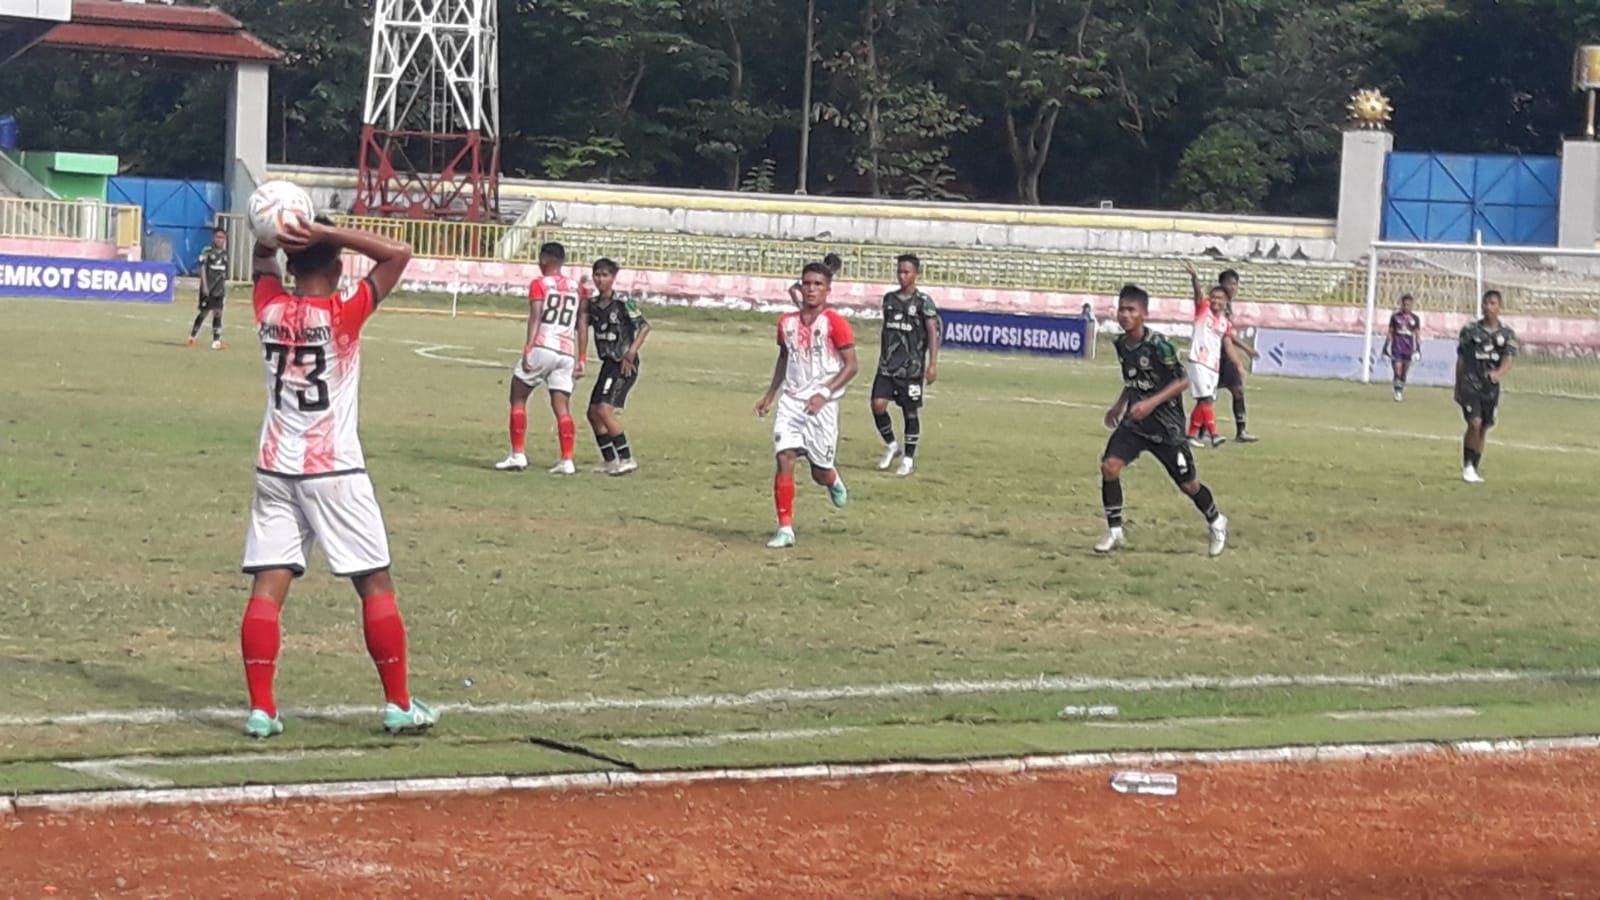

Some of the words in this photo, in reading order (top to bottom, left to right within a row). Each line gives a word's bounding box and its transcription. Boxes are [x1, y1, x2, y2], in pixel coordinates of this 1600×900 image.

[77, 268, 168, 293] SERANG
[542, 294, 576, 327] 86
[945, 322, 990, 343] ASKOT
[992, 326, 1022, 346] PSSI
[1023, 328, 1081, 351] SERANG
[265, 342, 330, 412] 73
